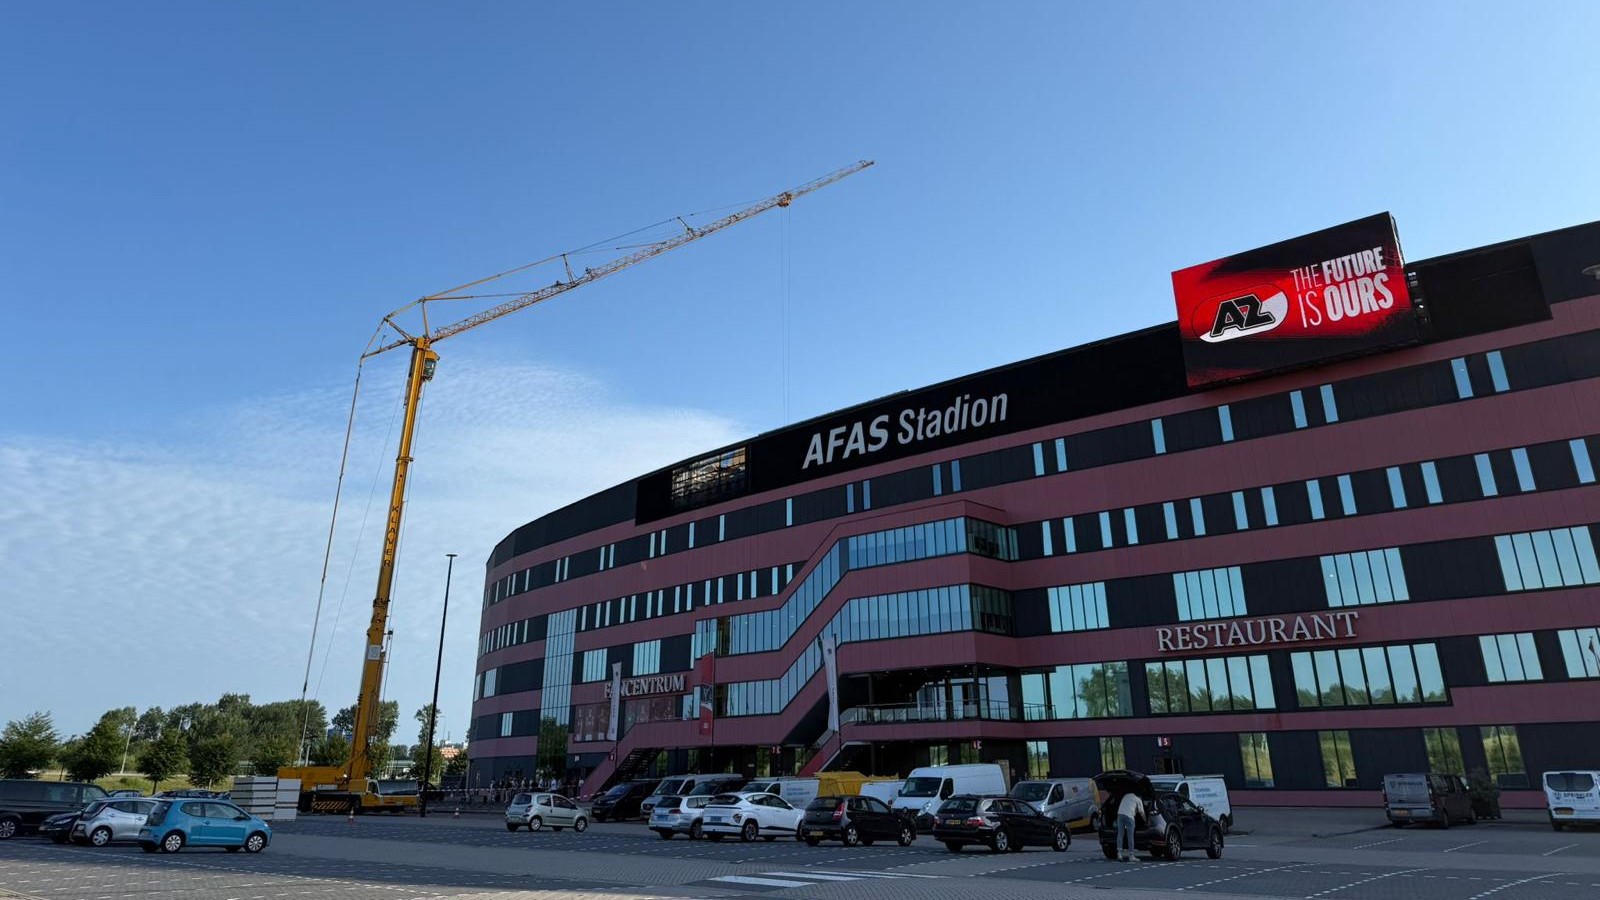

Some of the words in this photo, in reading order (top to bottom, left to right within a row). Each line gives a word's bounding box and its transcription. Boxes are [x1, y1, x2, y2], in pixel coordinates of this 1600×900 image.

[1290, 263, 1323, 292] THE
[1321, 246, 1386, 284] FUTURE
[1210, 294, 1276, 337] AZ
[1298, 291, 1322, 328] IS
[1323, 272, 1394, 322] OURS
[801, 414, 889, 470] AFAS
[897, 392, 1008, 445] Stadion
[383, 505, 399, 567] KLAVER
[1156, 611, 1359, 652] RESTAURANT
[604, 674, 685, 699] FNCENTRUM
